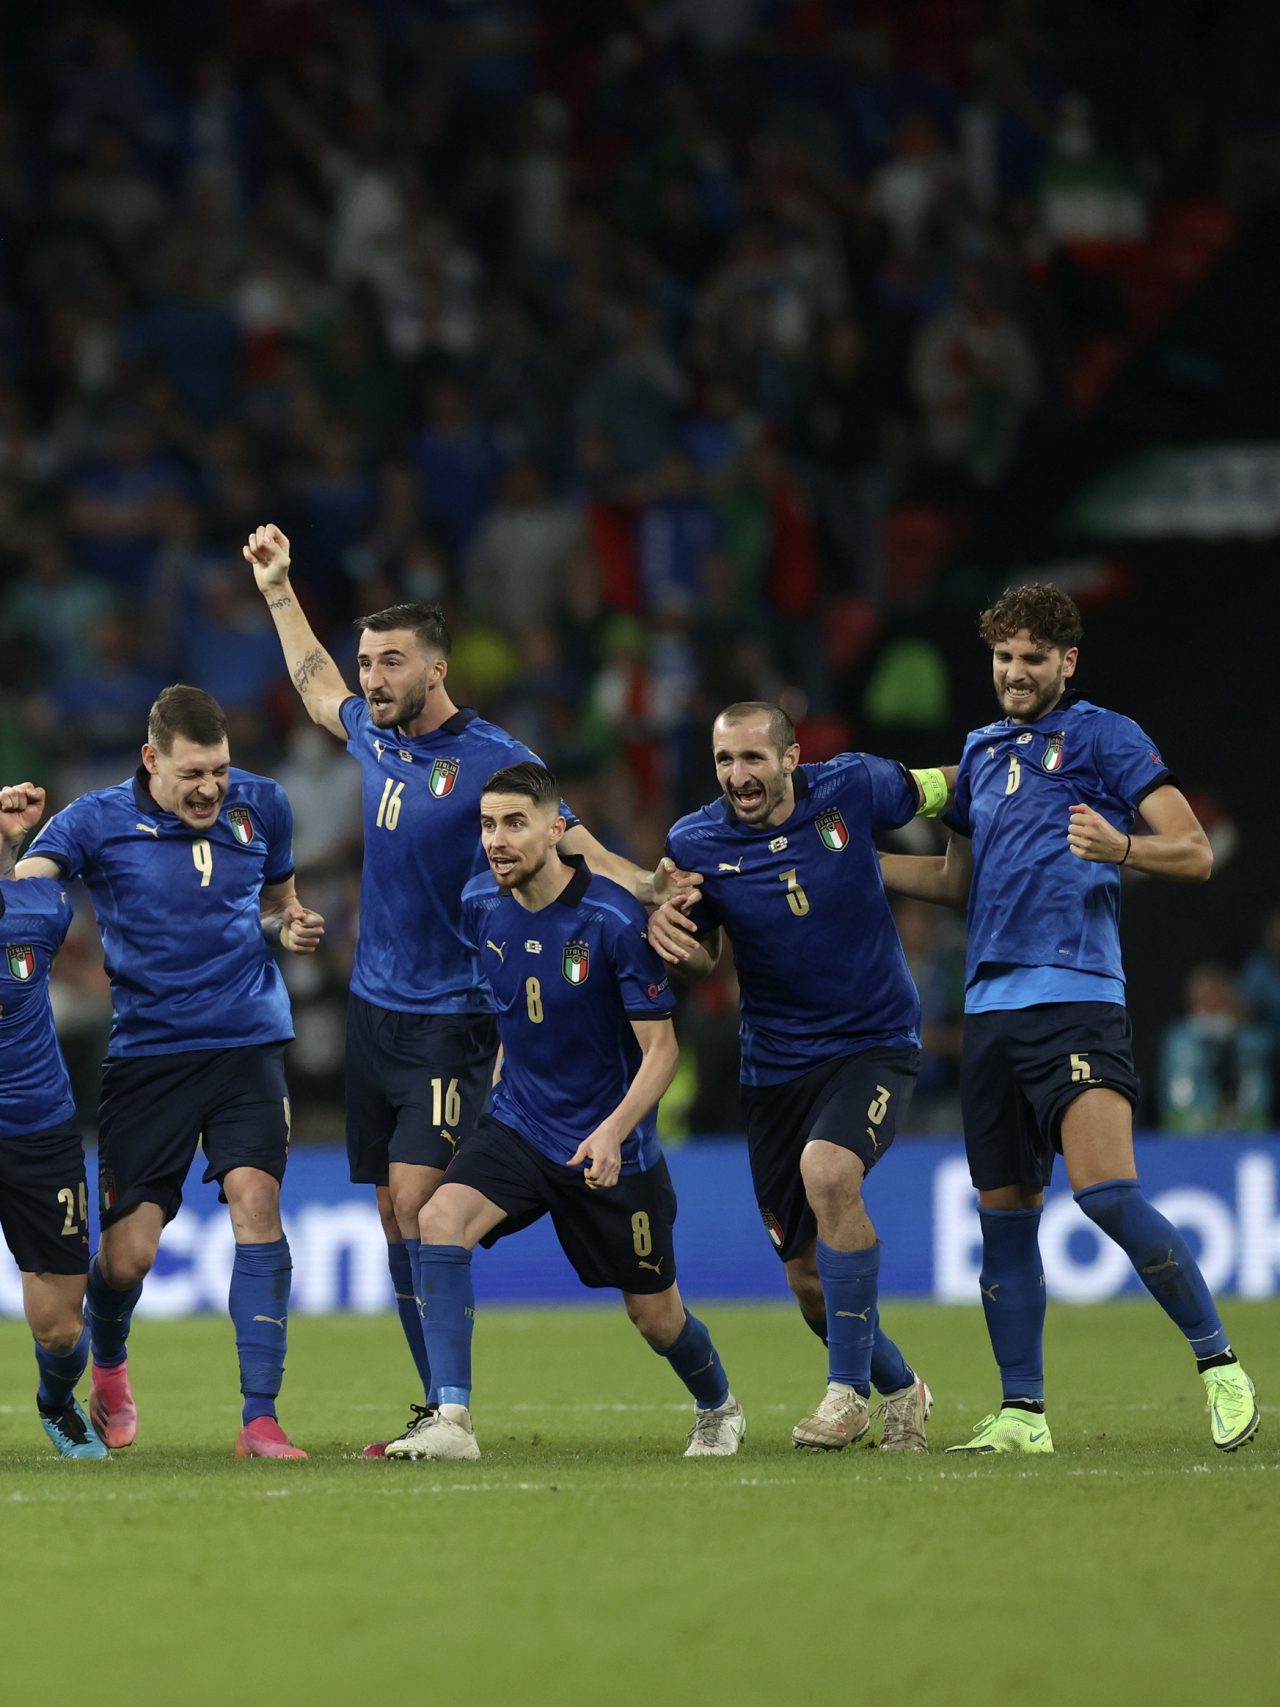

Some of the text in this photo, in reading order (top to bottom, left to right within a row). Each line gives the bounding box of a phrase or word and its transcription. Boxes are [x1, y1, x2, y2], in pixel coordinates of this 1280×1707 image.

[436, 760, 457, 773] ITALIA
[376, 777, 405, 831] 16
[192, 839, 213, 887] 9
[778, 868, 810, 917] 3
[565, 949, 588, 957] ITALIA
[525, 976, 544, 1024] 8
[431, 1078, 461, 1127] 16
[867, 1085, 891, 1125] 3
[631, 1210, 652, 1257] 8
